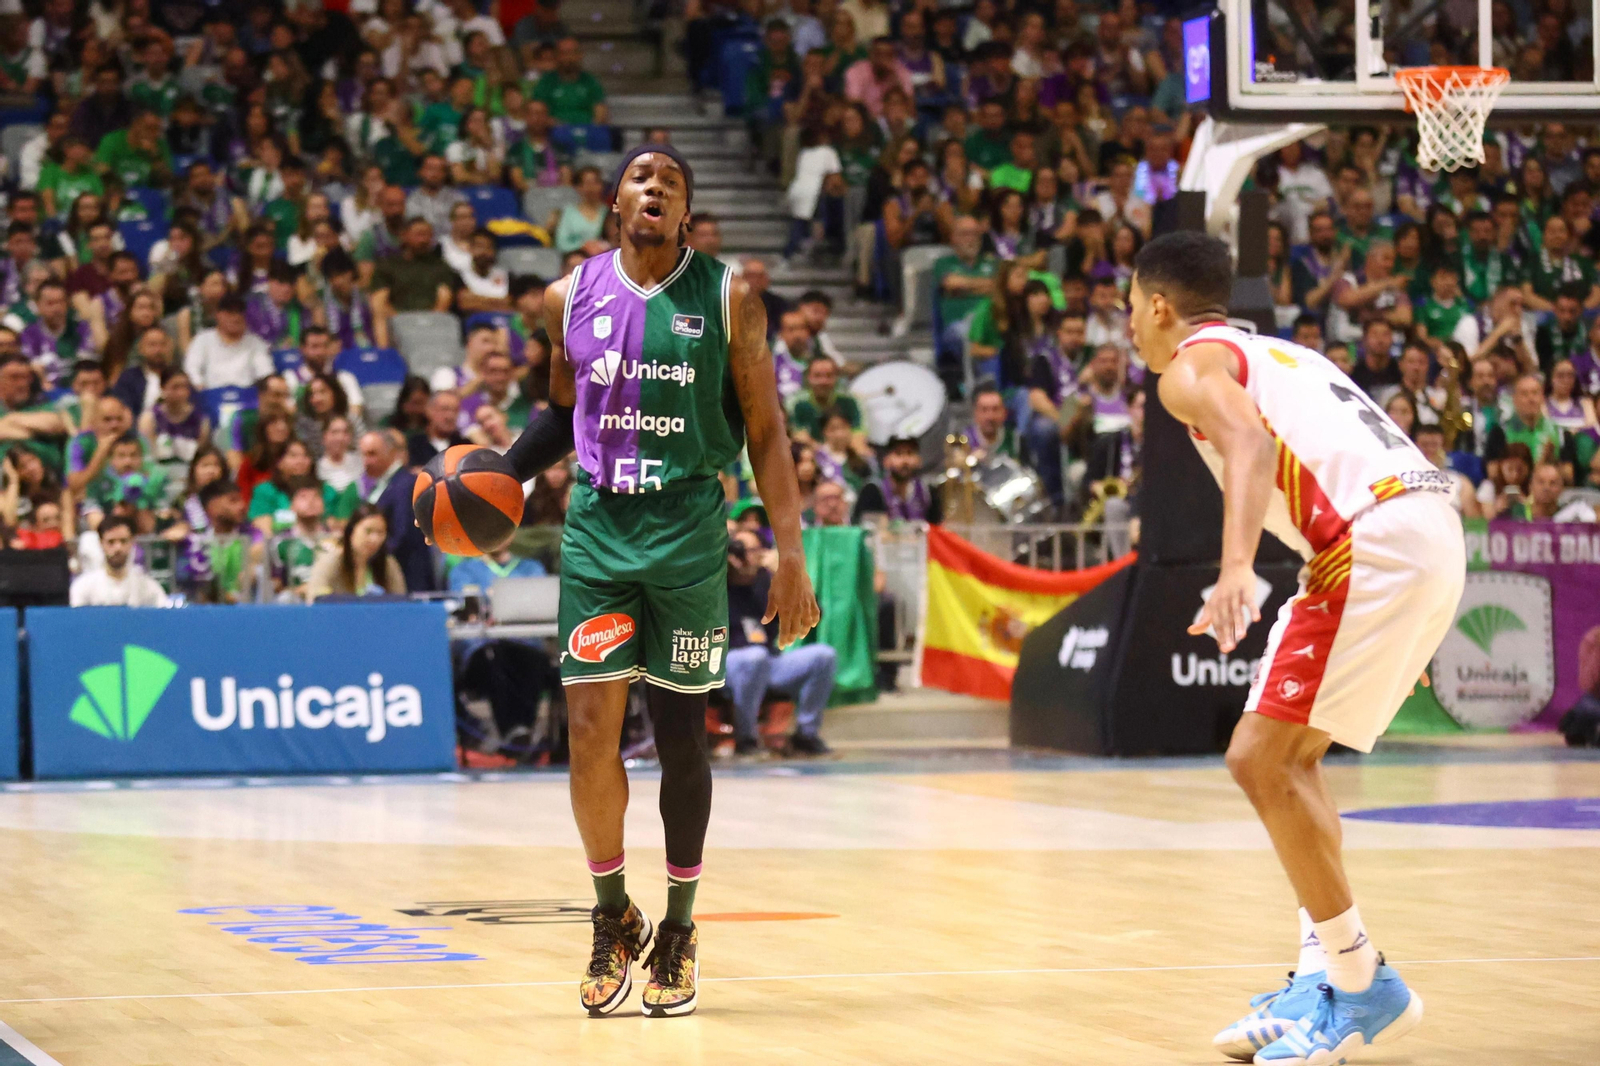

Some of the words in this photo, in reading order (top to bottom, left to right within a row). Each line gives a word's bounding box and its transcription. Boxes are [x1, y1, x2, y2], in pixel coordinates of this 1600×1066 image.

[622, 359, 696, 387] Unicaja
[611, 457, 663, 494] 55
[1512, 532, 1556, 565] DEL
[575, 618, 634, 655] famadesa
[672, 628, 693, 636] sabor
[671, 644, 709, 669] laga
[190, 672, 423, 743] Unicaja
[176, 904, 488, 966] endesa
